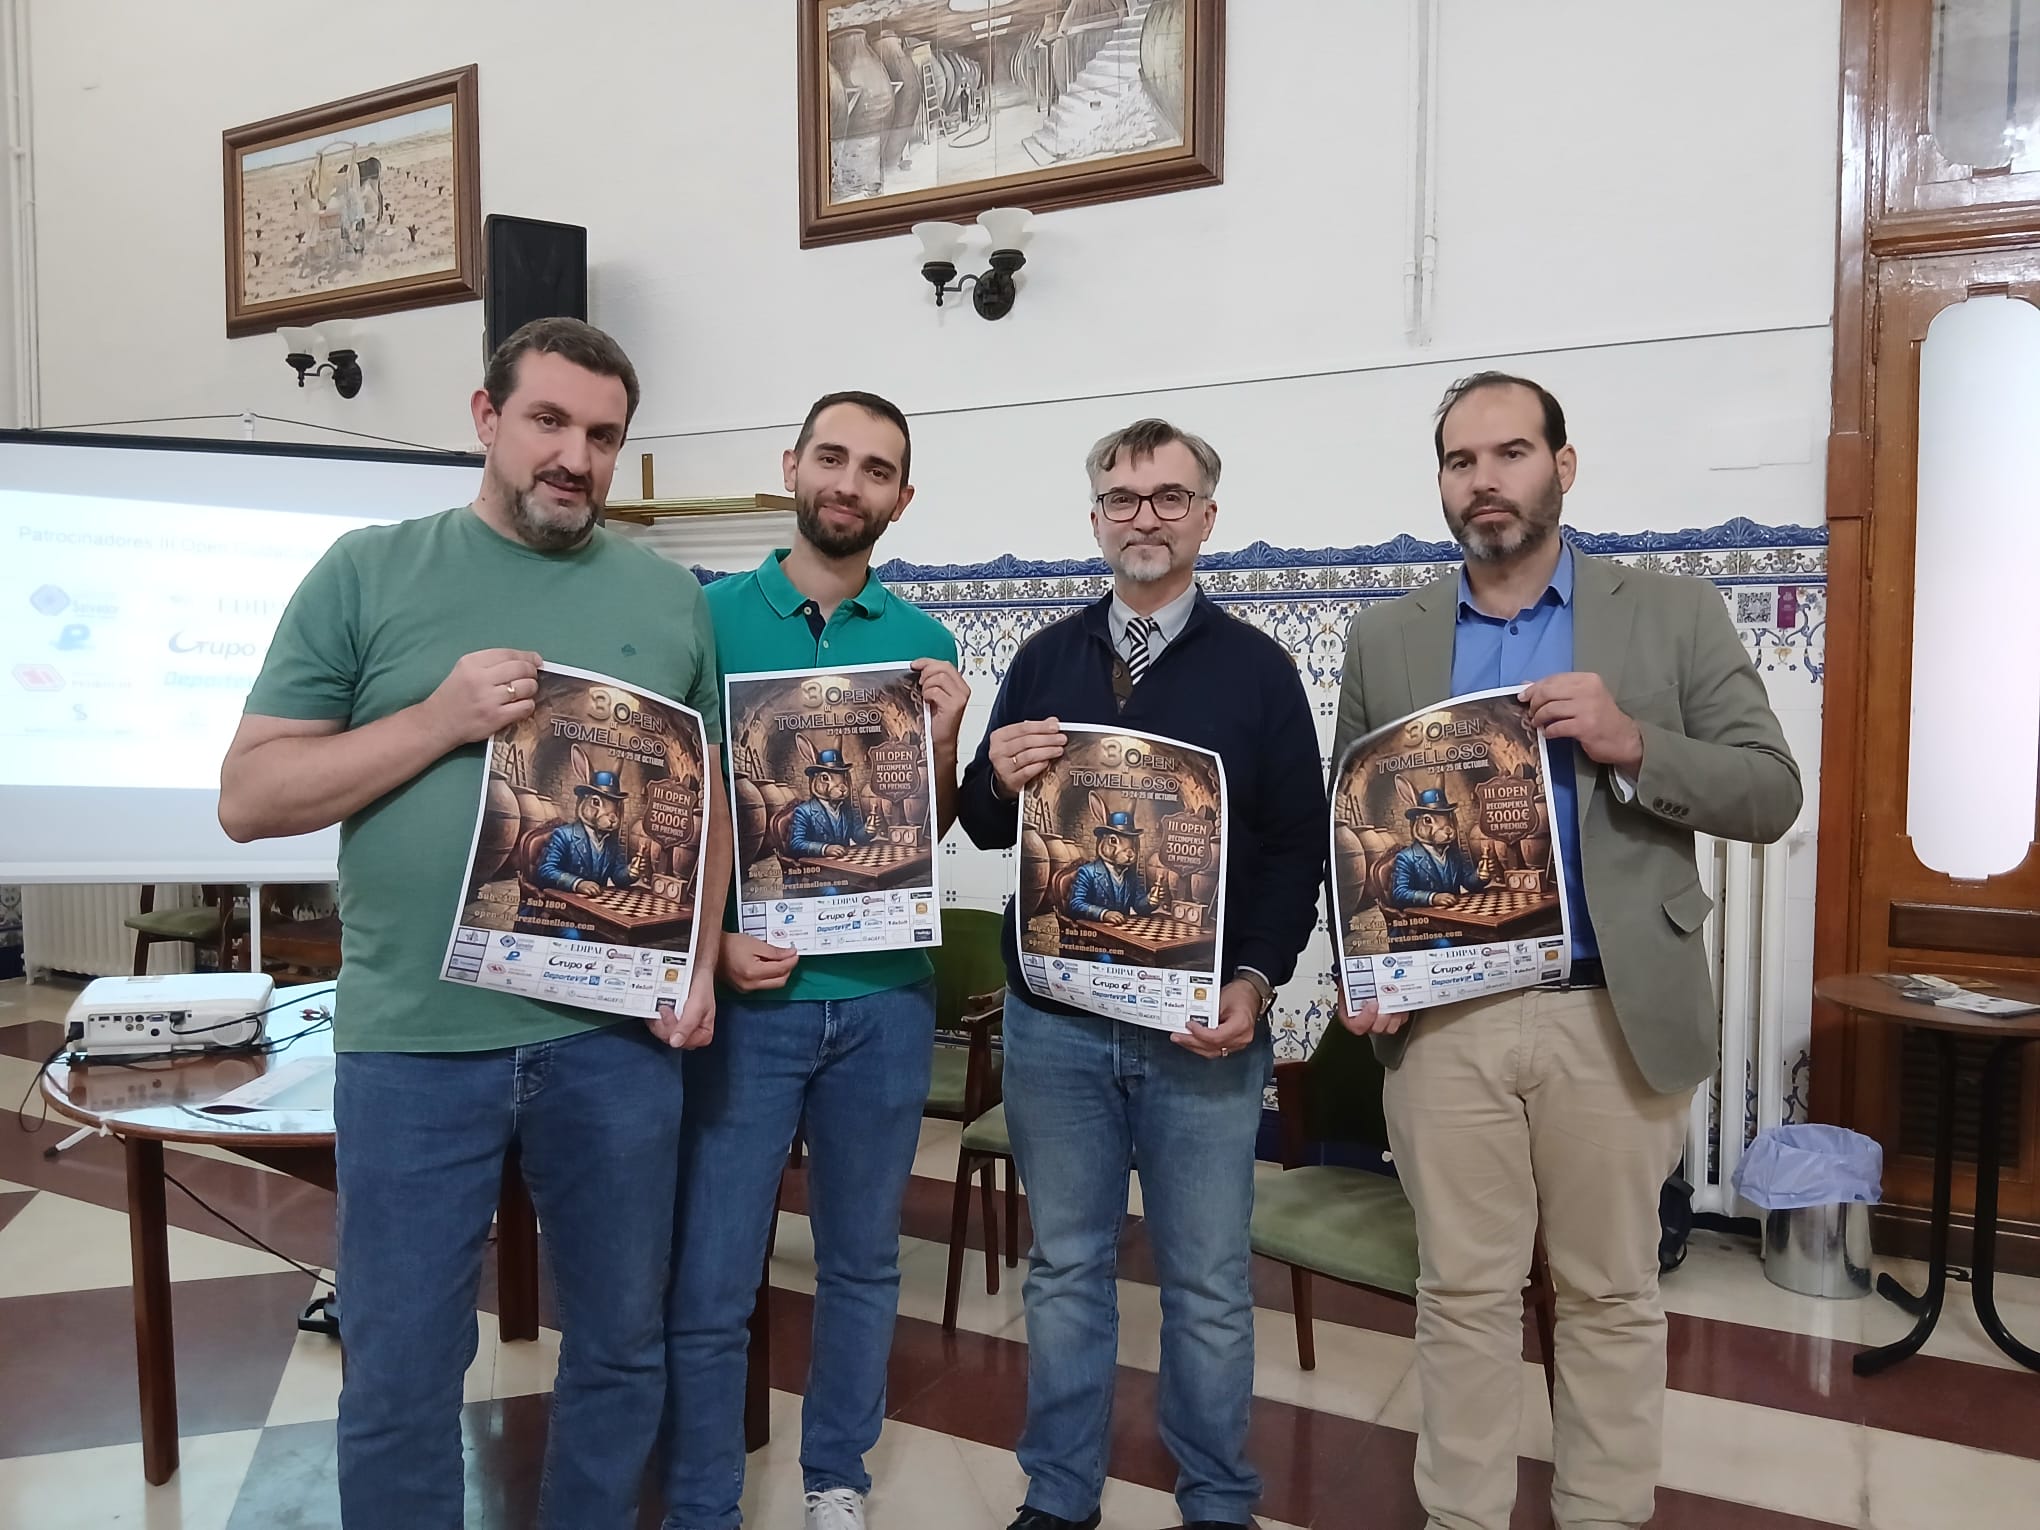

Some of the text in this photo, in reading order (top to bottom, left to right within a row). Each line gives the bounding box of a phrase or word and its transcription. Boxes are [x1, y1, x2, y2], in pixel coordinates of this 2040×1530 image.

[18, 526, 152, 549] Patrocinadores
[168, 629, 256, 661] Grupo
[801, 681, 877, 708] 3 OPEN
[613, 703, 663, 733] OPEN
[775, 710, 881, 731] TOMELLOSO
[551, 719, 666, 756] TOMELLOSO
[1404, 718, 1480, 747] 3 OPEN
[875, 751, 913, 761] III OPEN
[1124, 748, 1175, 771] OPEN
[1376, 742, 1488, 774] TOMELLOSO
[877, 764, 912, 772] RECOMPENSA
[1463, 759, 1490, 770] OCTUBRE
[877, 771, 913, 783] 3000€
[1069, 770, 1179, 793] TOMELLOSO
[654, 787, 691, 806] III OPEN
[1484, 786, 1528, 799] III OPEN
[652, 802, 688, 816] RECOMPENSA
[1486, 801, 1528, 811] RECOMPENSA
[650, 810, 688, 829] 3000€
[1486, 809, 1529, 822] 3000€
[1168, 821, 1207, 834] III OPEN
[1490, 822, 1528, 831] EN PREMIOS
[1167, 835, 1205, 844] RECOMPENSA
[1167, 843, 1205, 857] 3000€
[526, 898, 544, 908] Sub
[545, 900, 567, 910] 1800
[818, 910, 845, 921] Grupo
[1393, 919, 1408, 927] Sub
[1410, 917, 1429, 926] 1800
[1065, 928, 1079, 936] Sub
[548, 955, 583, 969] Grupo
[1431, 963, 1463, 974] Grupo
[1092, 977, 1119, 989] Grupo
